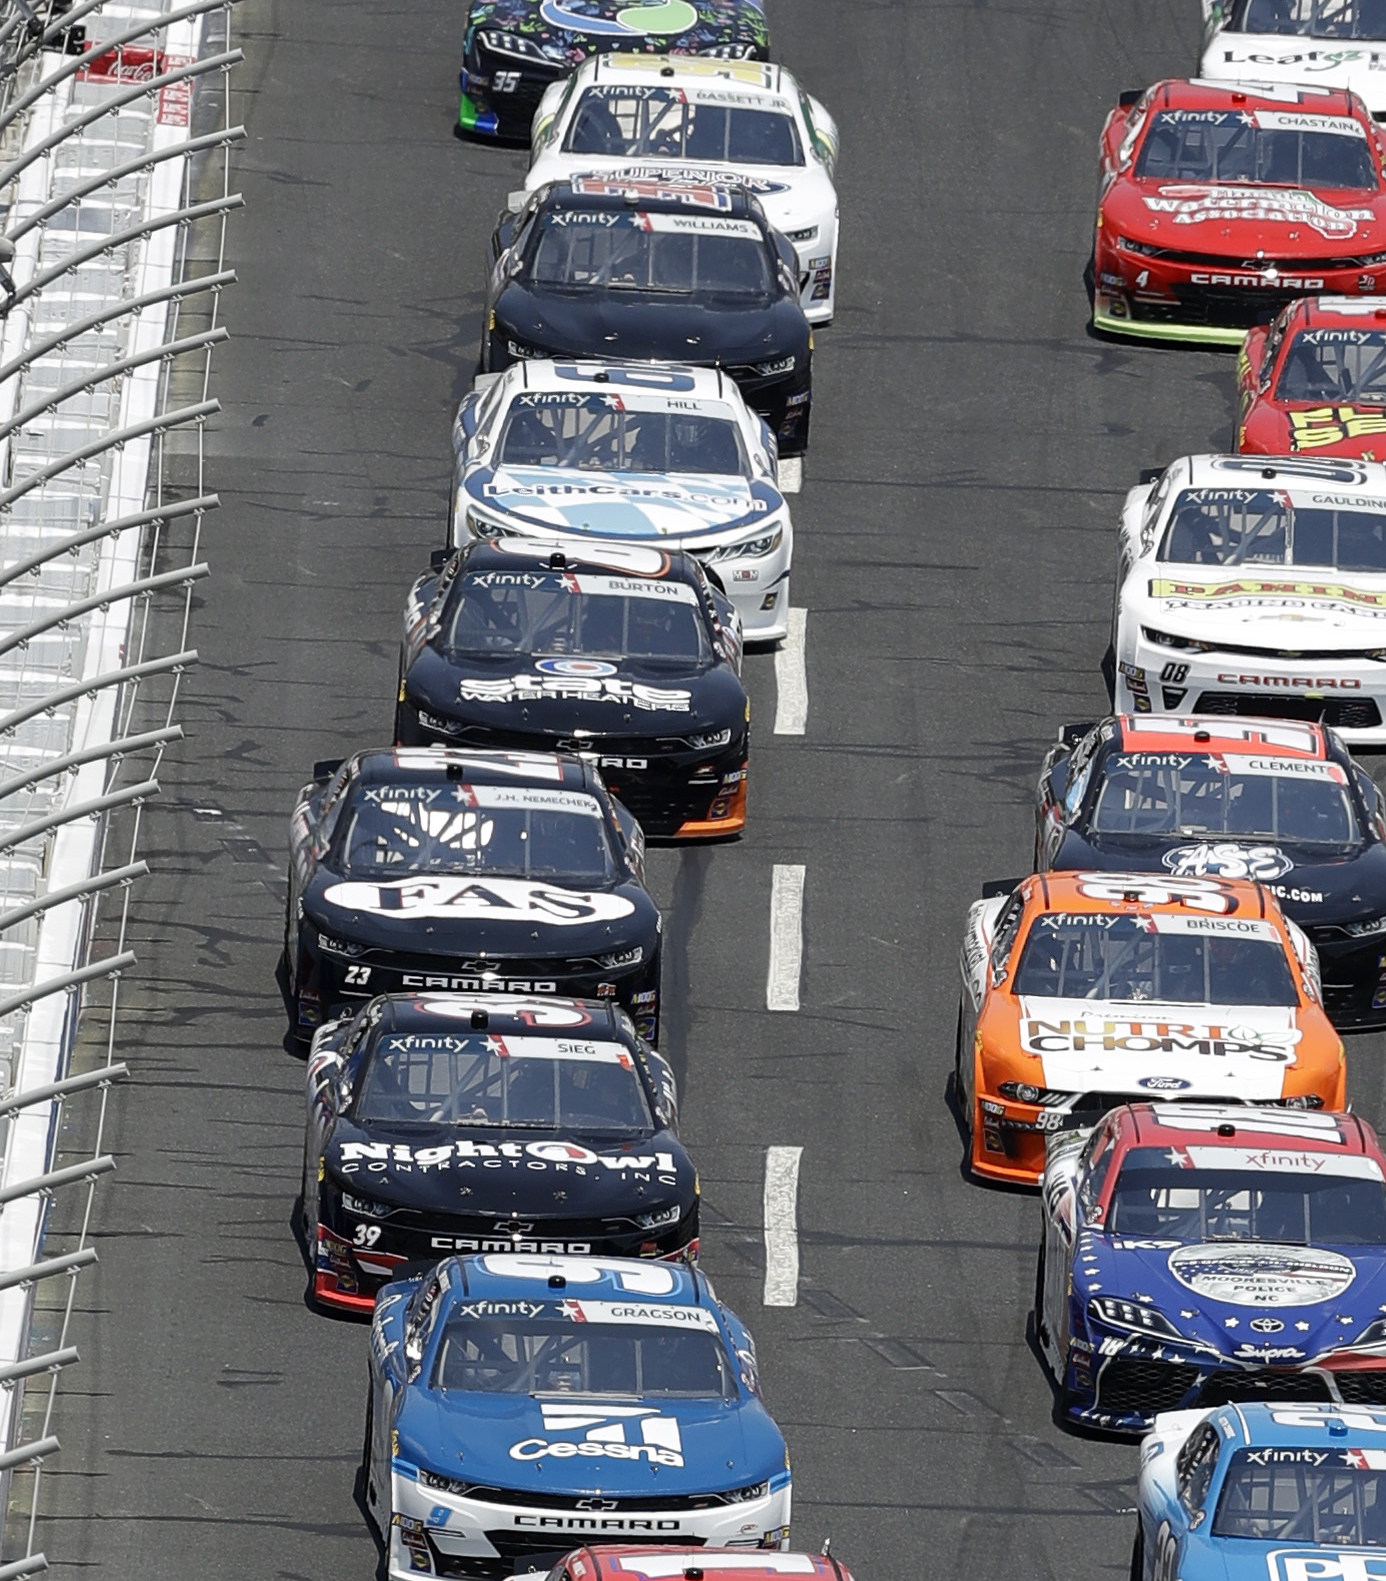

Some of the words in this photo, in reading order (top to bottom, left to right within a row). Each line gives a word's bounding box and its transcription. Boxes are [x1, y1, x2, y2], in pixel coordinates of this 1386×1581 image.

[589, 86, 656, 100] xfinity
[1161, 110, 1230, 125] xfinity
[1277, 116, 1356, 130] CHASTAIN
[551, 212, 621, 227] xfinity
[673, 219, 749, 233] WILLIAMS
[1135, 271, 1149, 288] 4
[1190, 274, 1324, 289] CAMARO
[1301, 330, 1372, 345] xfinity
[519, 392, 592, 407] xfinity
[666, 398, 703, 411] HILL
[482, 482, 768, 512] LeithCars.com
[1185, 489, 1259, 504] xfinity
[472, 573, 546, 589] xfinity
[608, 580, 680, 596] BURTON
[1160, 662, 1190, 683] 08
[1217, 673, 1361, 689] CAMARO
[1116, 753, 1193, 770] xfinity
[364, 786, 443, 802] xfinity
[1174, 845, 1281, 879] ASE
[369, 884, 598, 919] FAS
[1041, 913, 1120, 929] xfinity
[1186, 920, 1261, 934] BRISCOE
[344, 965, 372, 986] 23
[402, 975, 557, 992] CAMARO
[1028, 1020, 1226, 1041] NUTRI
[388, 1035, 469, 1054] xfinity
[557, 1043, 596, 1055] SIEG
[1029, 1036, 1288, 1062] CHOMPS
[1150, 1077, 1182, 1090] Ford
[1036, 1112, 1063, 1131] 98
[1245, 1152, 1326, 1171] xfinity
[621, 1172, 676, 1185] INC
[352, 1224, 382, 1247] 39
[430, 1237, 591, 1254] CAMARO
[1202, 1275, 1328, 1286] MOORESVILLE
[1233, 1285, 1297, 1293] POLICE
[460, 1301, 545, 1319] xfinity
[611, 1306, 700, 1321] GRAGSON
[1099, 1336, 1129, 1355] 18
[508, 1438, 685, 1468] Cessna
[1246, 1448, 1330, 1467] xfinity
[513, 1515, 680, 1530] CAMARO
